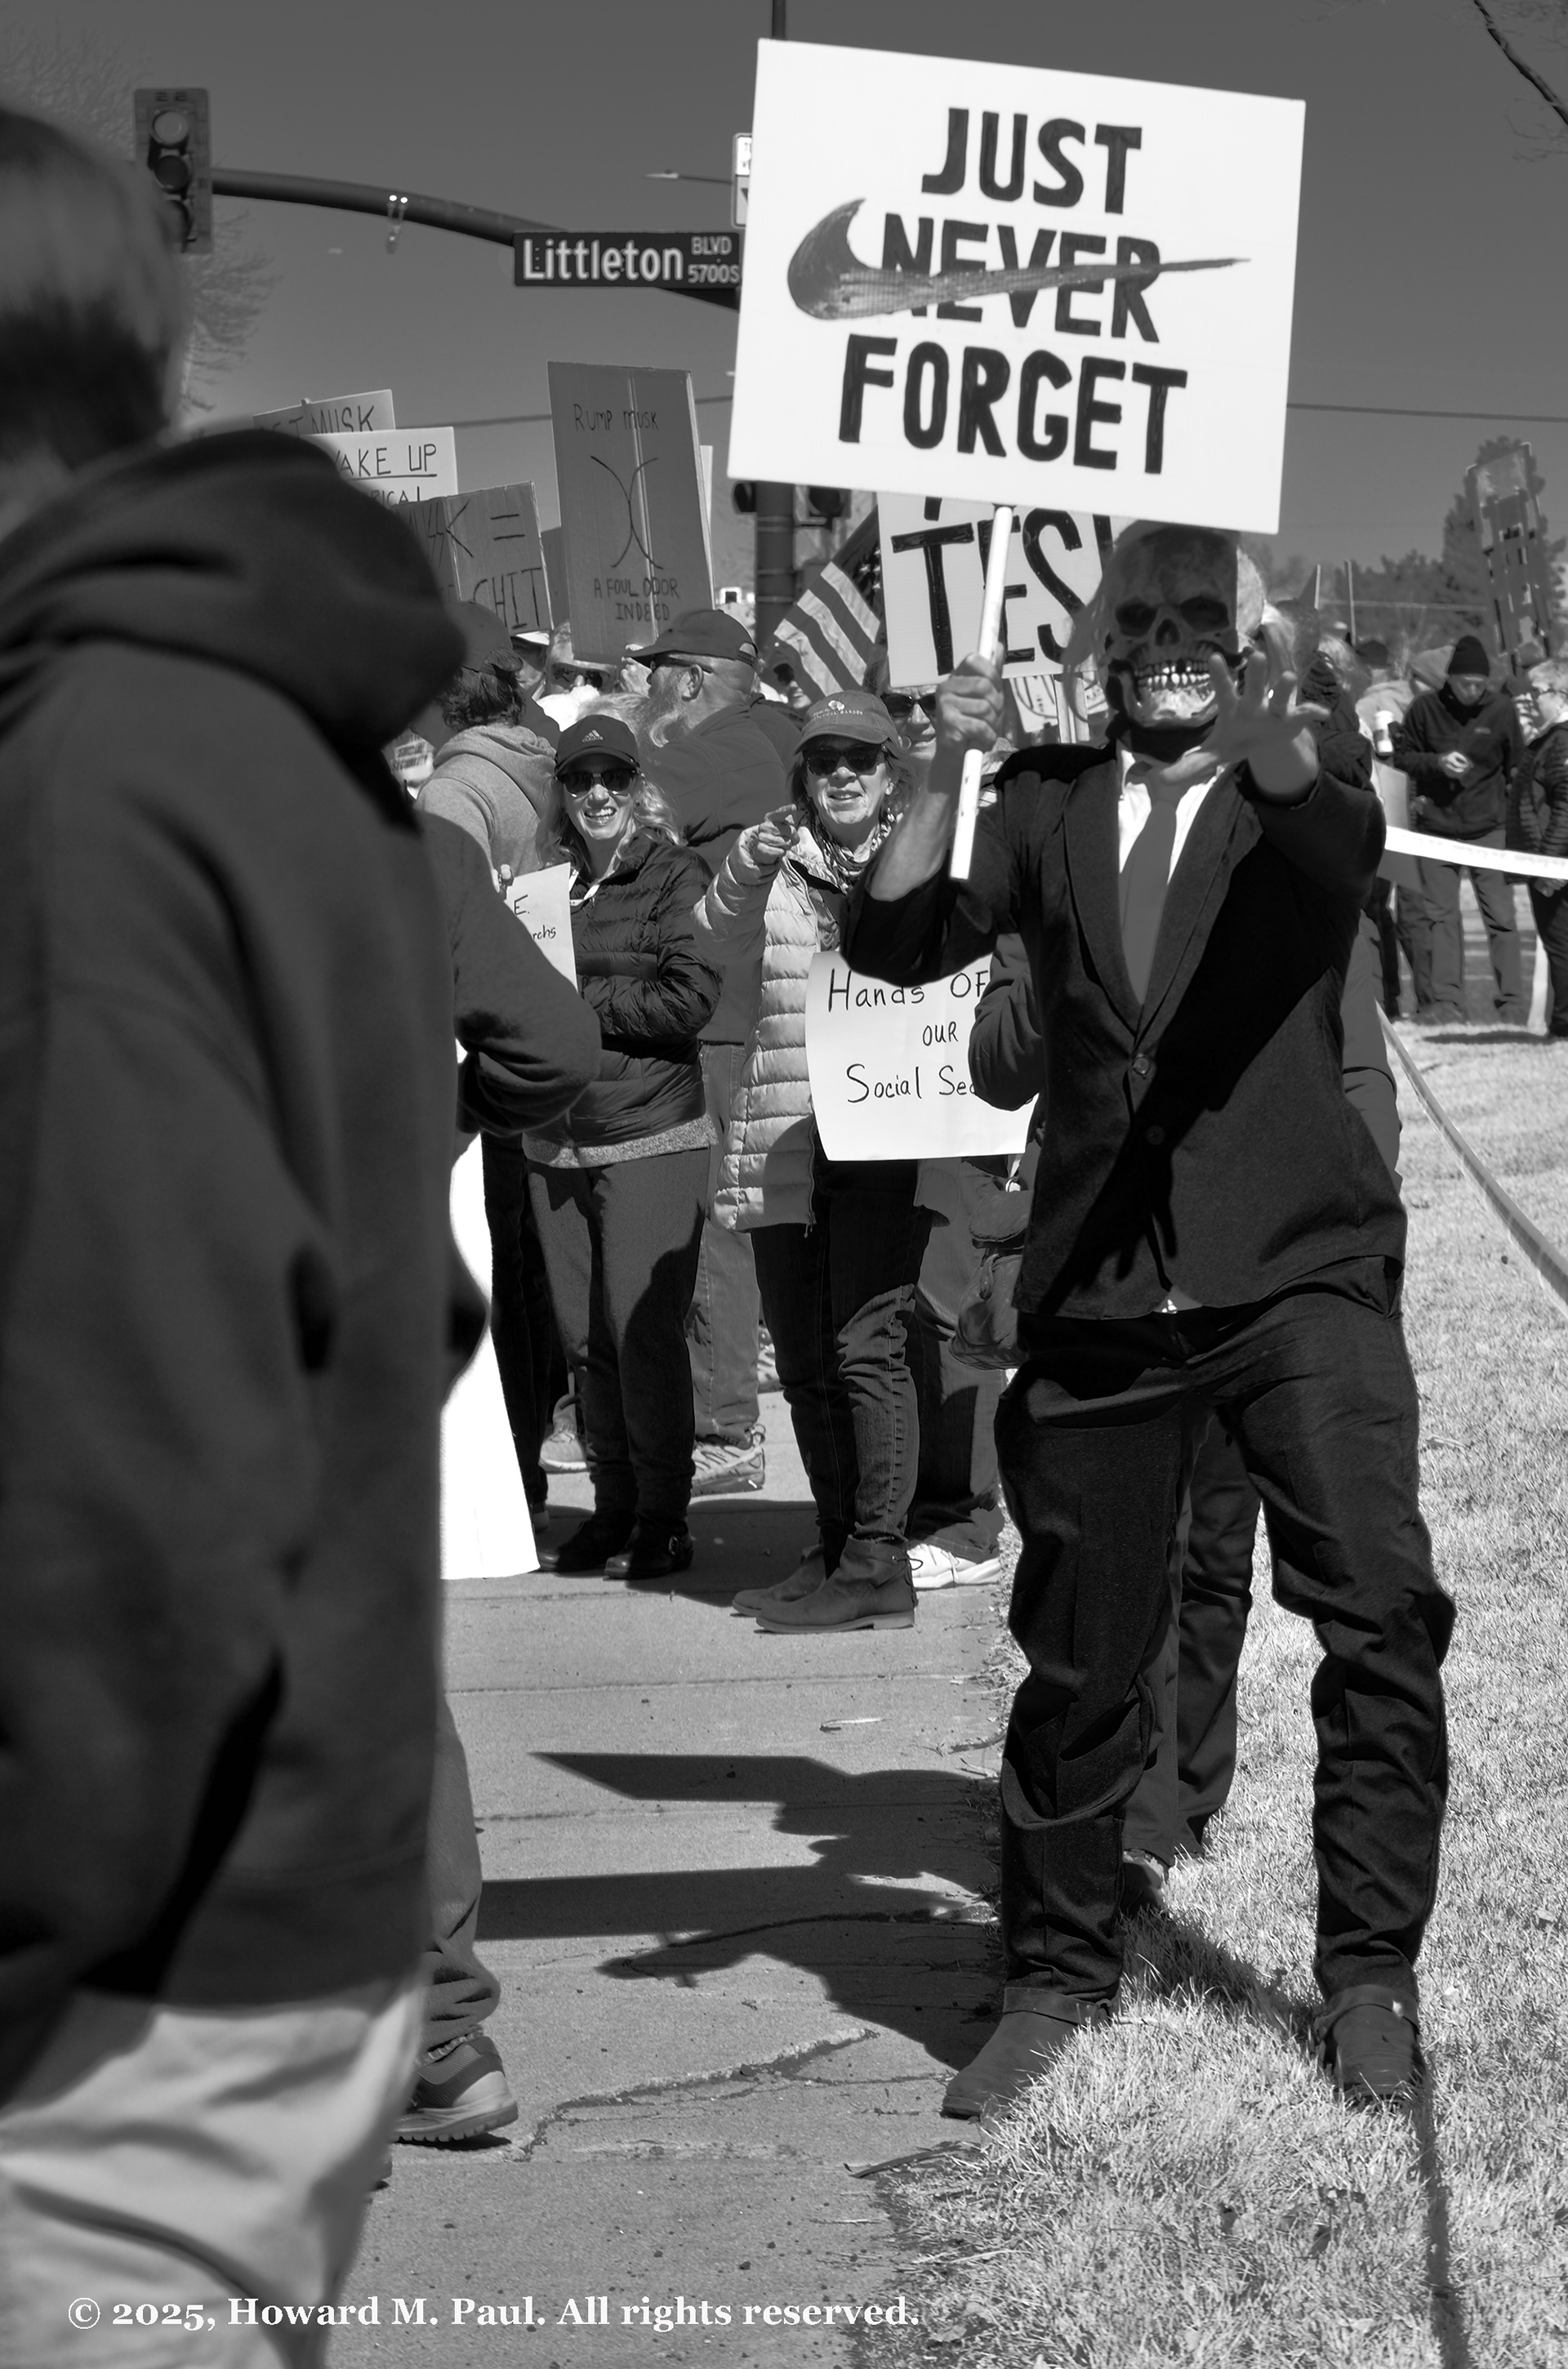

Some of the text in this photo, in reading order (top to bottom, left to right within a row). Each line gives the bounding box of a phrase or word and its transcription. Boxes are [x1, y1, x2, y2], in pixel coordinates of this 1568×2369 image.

[921, 107, 1143, 214] JUST
[522, 239, 684, 281] Littleton
[691, 235, 733, 256] BLVD
[687, 263, 740, 283] 5700S
[881, 212, 1161, 343] NEVER
[839, 333, 1188, 474] FORGET
[408, 443, 437, 472] UP
[594, 577, 679, 600] A FOUL ODOR
[828, 967, 925, 1012] Hands
[846, 1063, 922, 1104] Social
